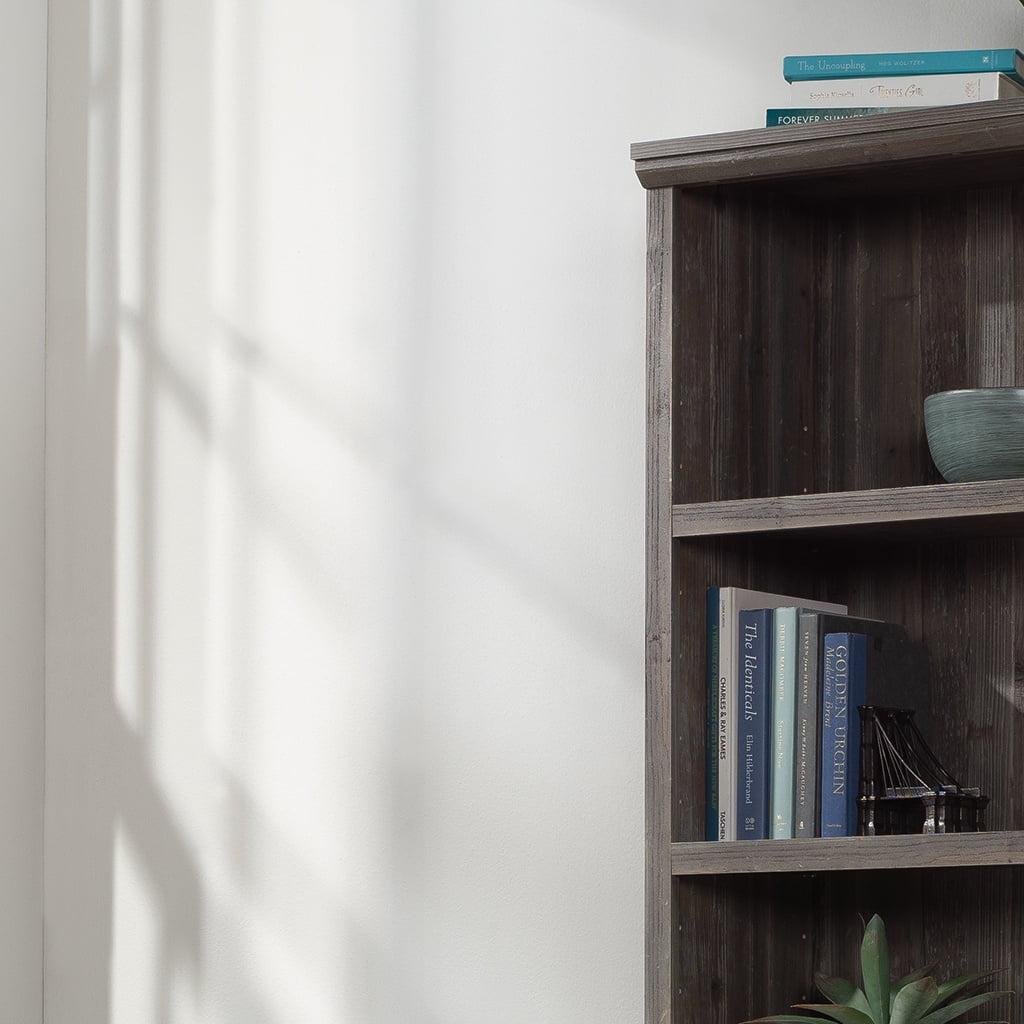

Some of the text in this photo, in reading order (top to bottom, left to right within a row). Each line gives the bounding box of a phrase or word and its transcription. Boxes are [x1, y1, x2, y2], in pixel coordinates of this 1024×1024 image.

[797, 59, 866, 72] The Uncoupling
[777, 115, 820, 126] FOREVER
[744, 623, 758, 721] The Identicals
[824, 646, 835, 729] Madeleine Brent
[719, 677, 727, 709] CHARLES
[719, 719, 727, 733] RAY
[832, 645, 848, 795] GOLDEN URCHIN
[719, 735, 727, 760] EAMES
[745, 735, 753, 805] Elin Hilderbrand
